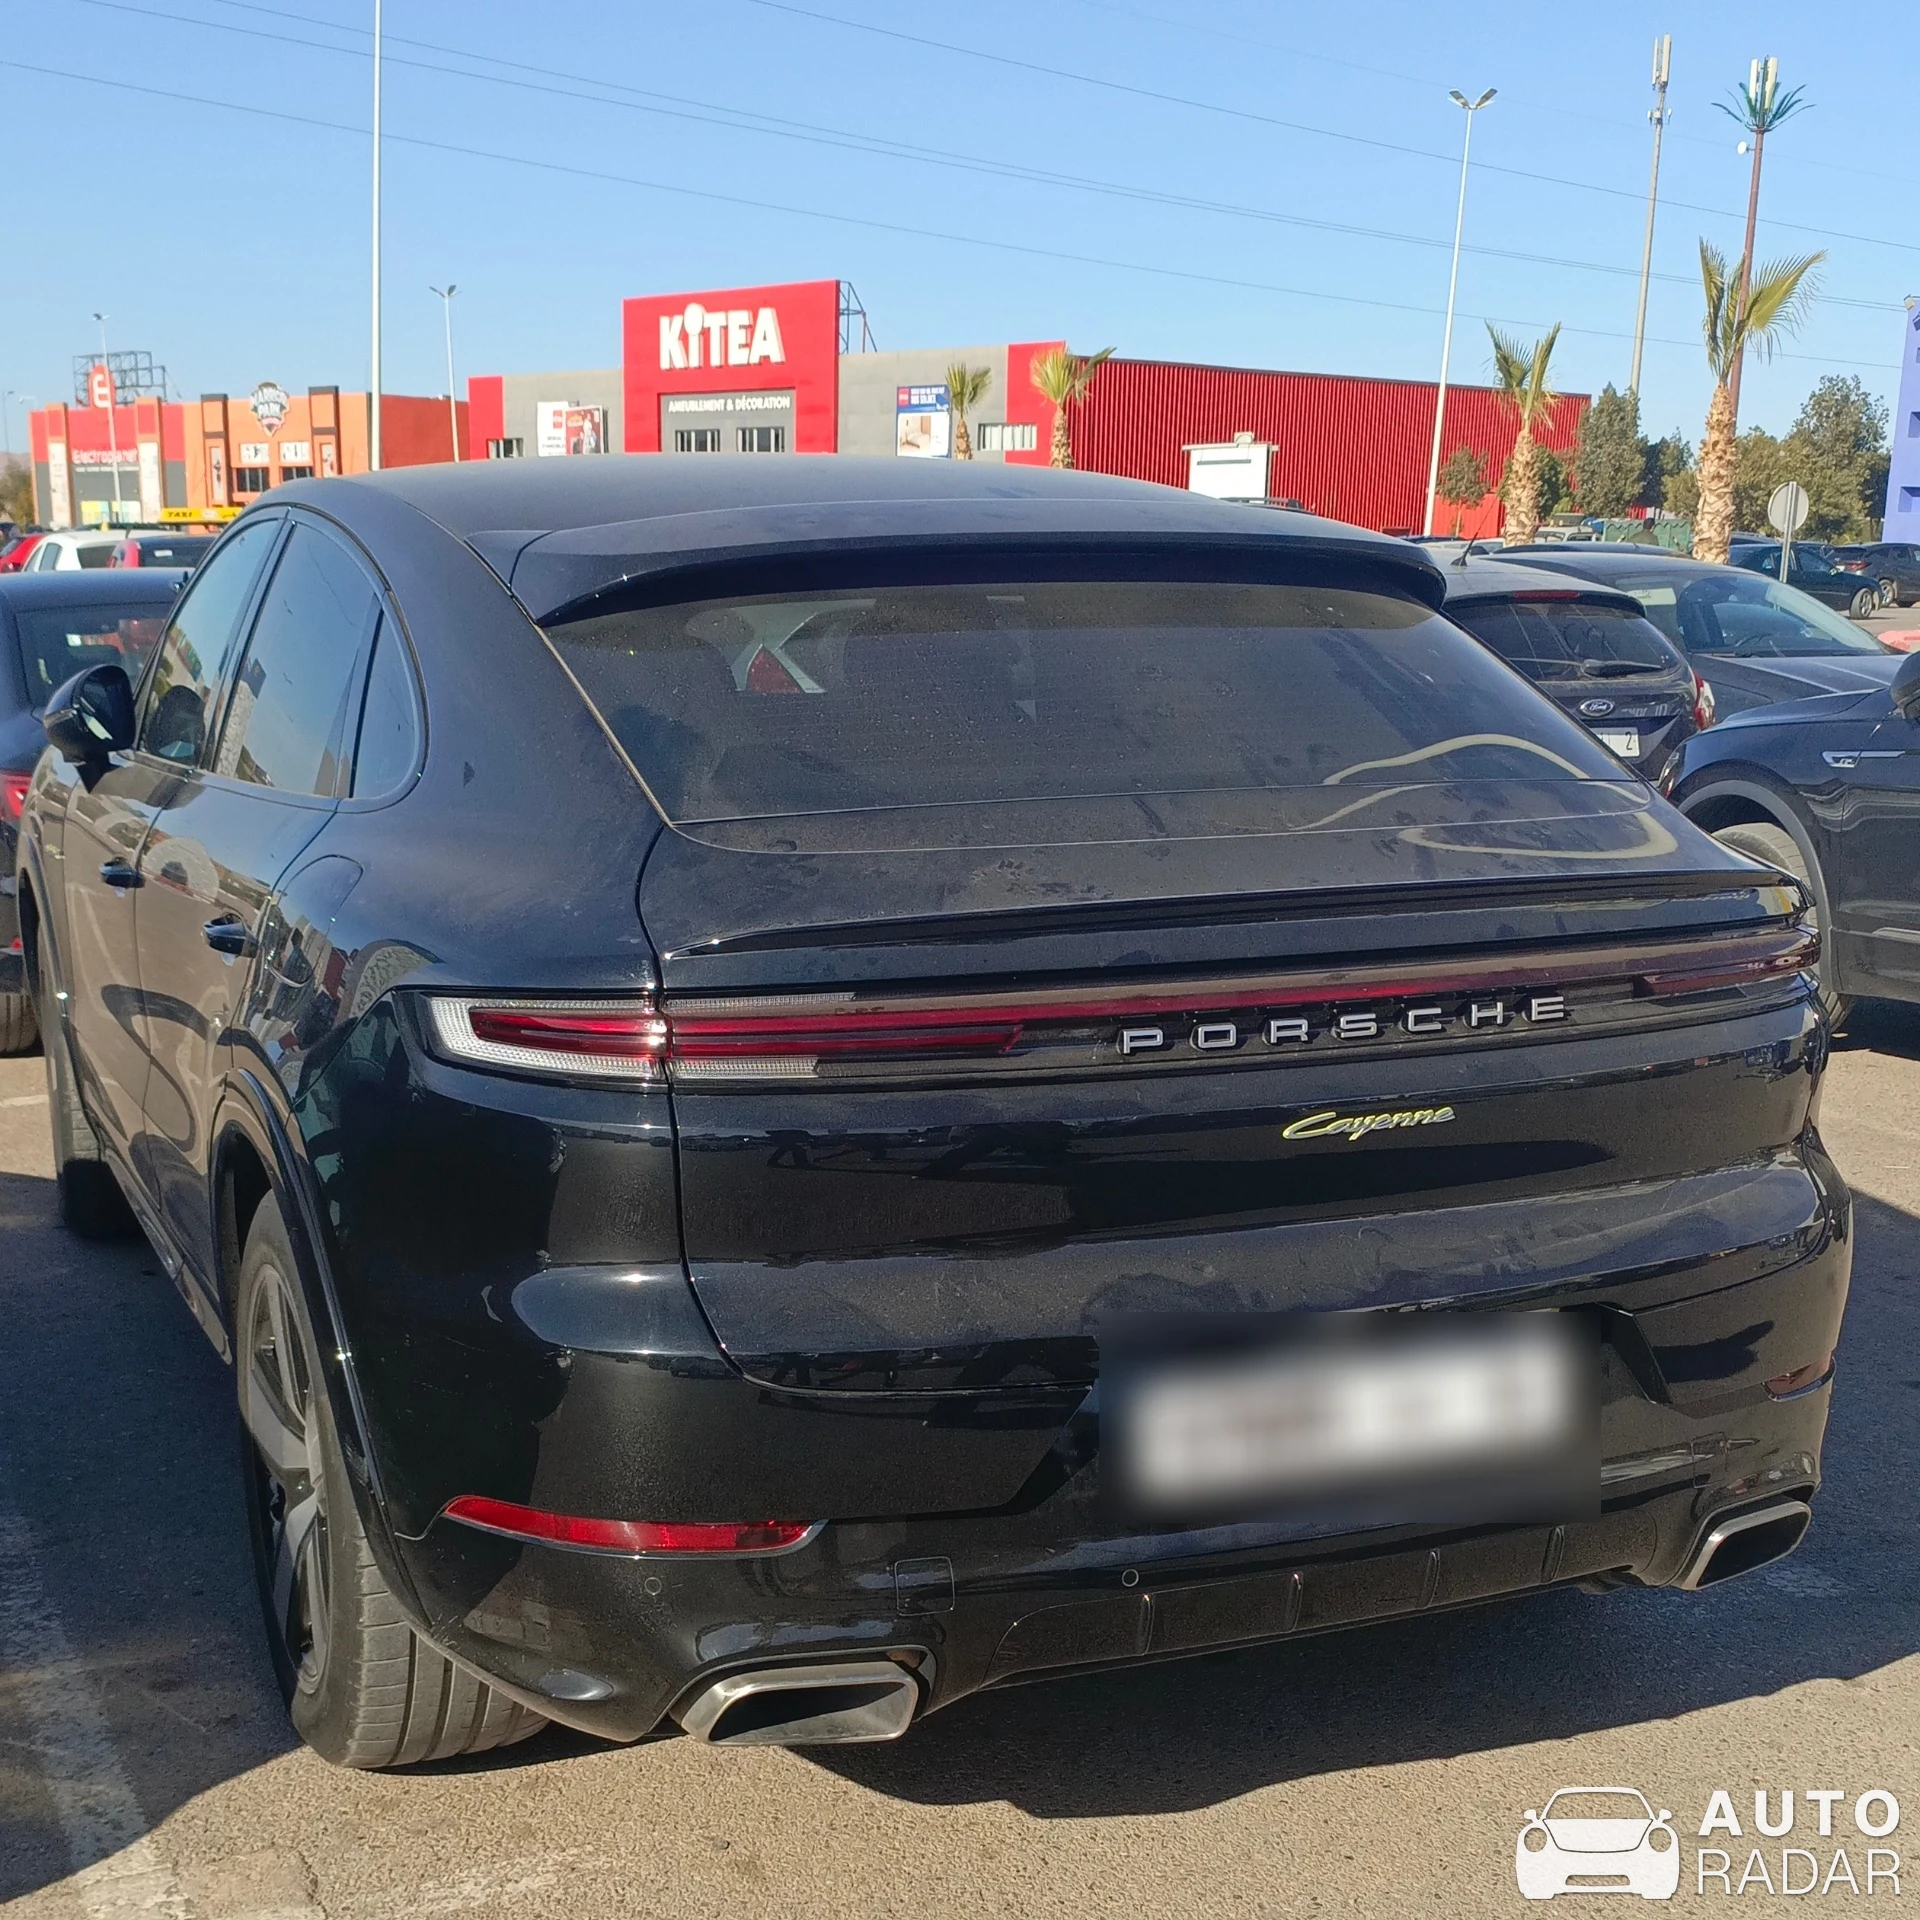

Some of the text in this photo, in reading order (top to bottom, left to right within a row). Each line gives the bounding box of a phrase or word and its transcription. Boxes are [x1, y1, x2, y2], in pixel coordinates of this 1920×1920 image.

[726, 398, 734, 412] &
[735, 395, 791, 412] DÉCORATION
[1120, 995, 1565, 1055] PORSCHE
[1282, 1105, 1457, 1141] Cayenne
